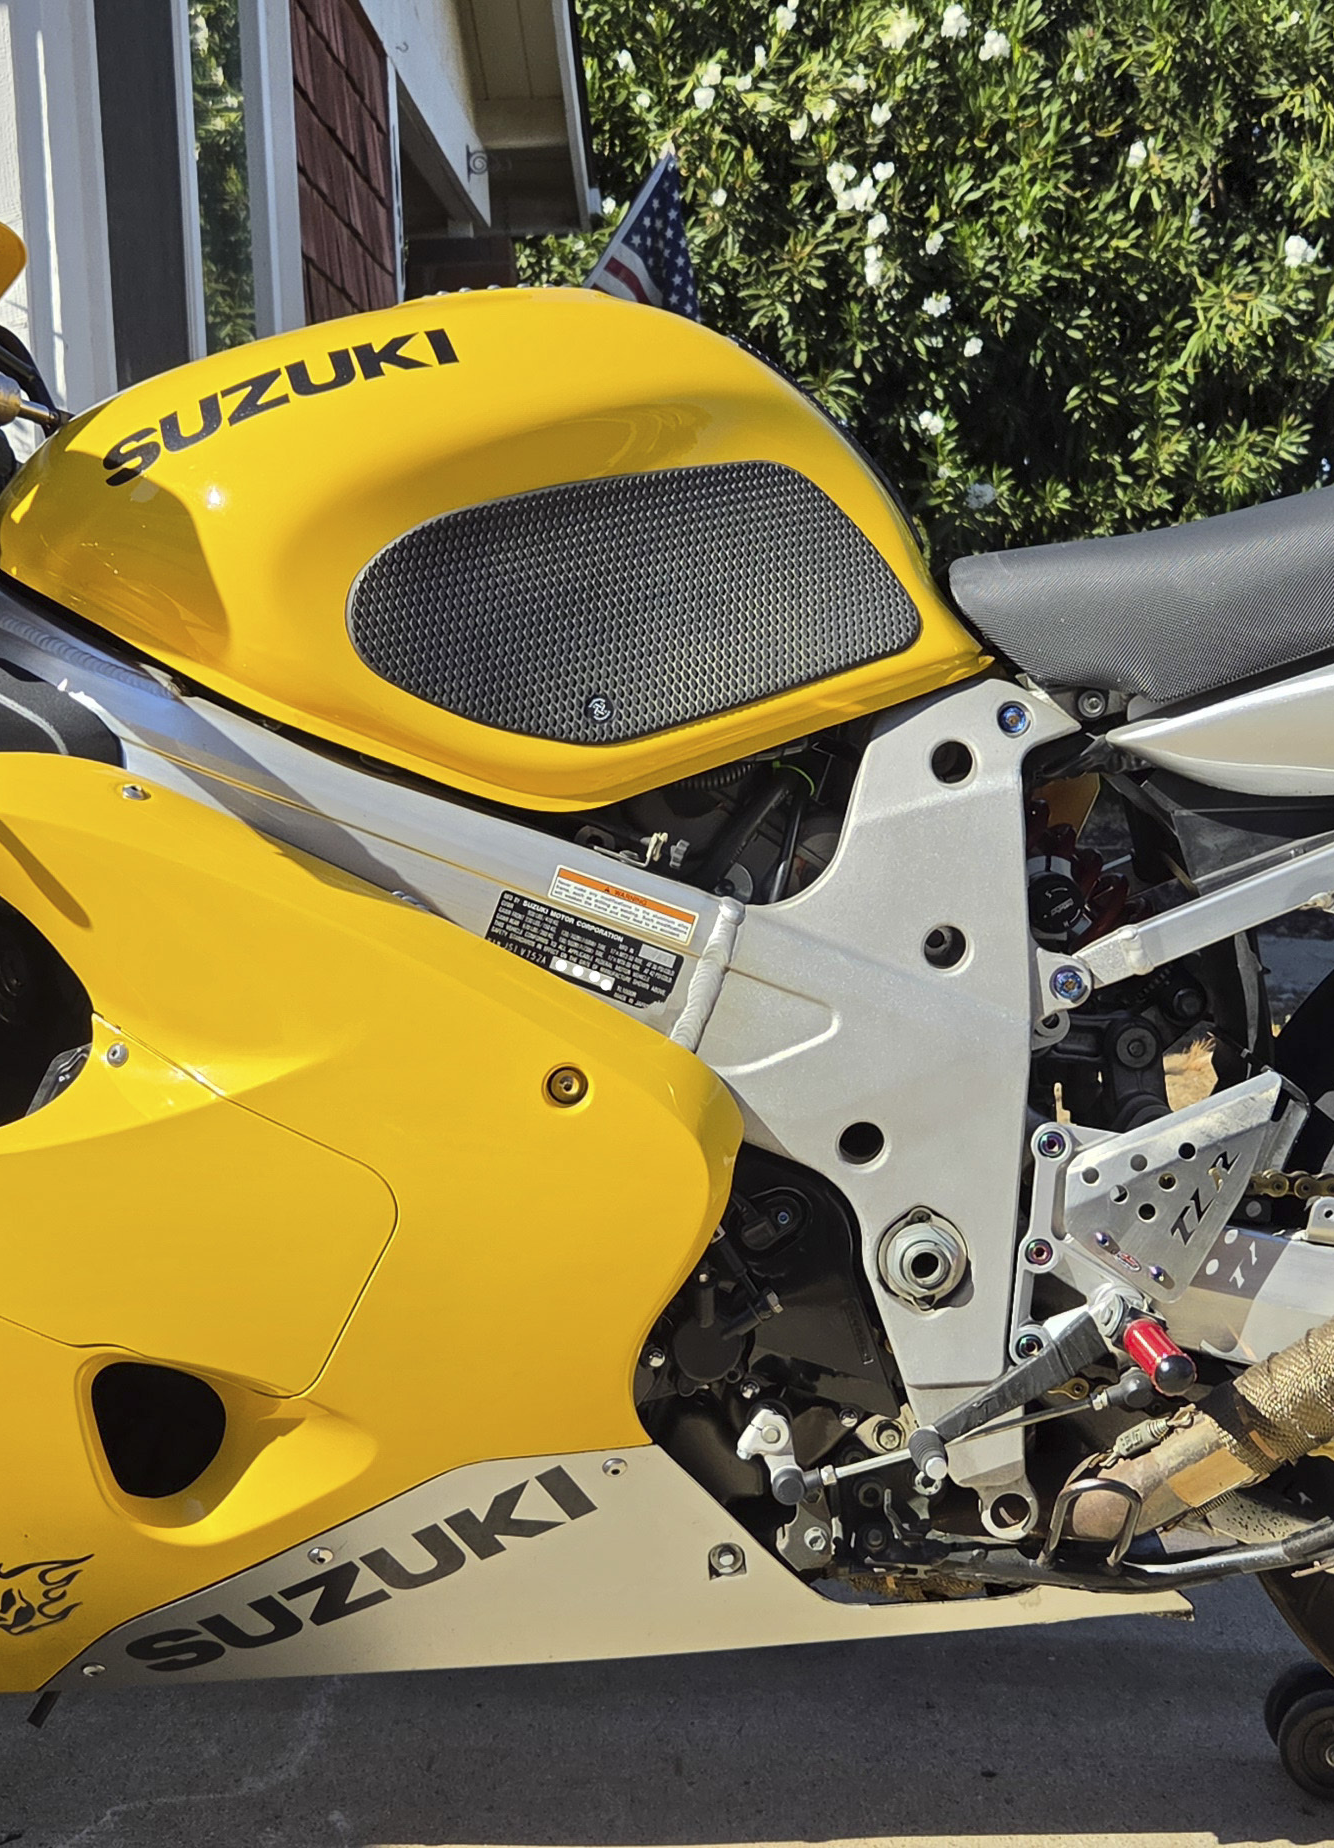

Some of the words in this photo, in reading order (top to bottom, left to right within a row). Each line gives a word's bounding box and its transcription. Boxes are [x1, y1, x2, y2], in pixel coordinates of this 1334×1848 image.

[102, 328, 459, 487] SUZUKI
[522, 899, 549, 914] SUZUKI
[549, 909, 575, 924] MOTOR
[575, 919, 624, 942] CORPORATION
[613, 889, 647, 905] WARNING
[124, 1464, 598, 1672] SUZUKI
